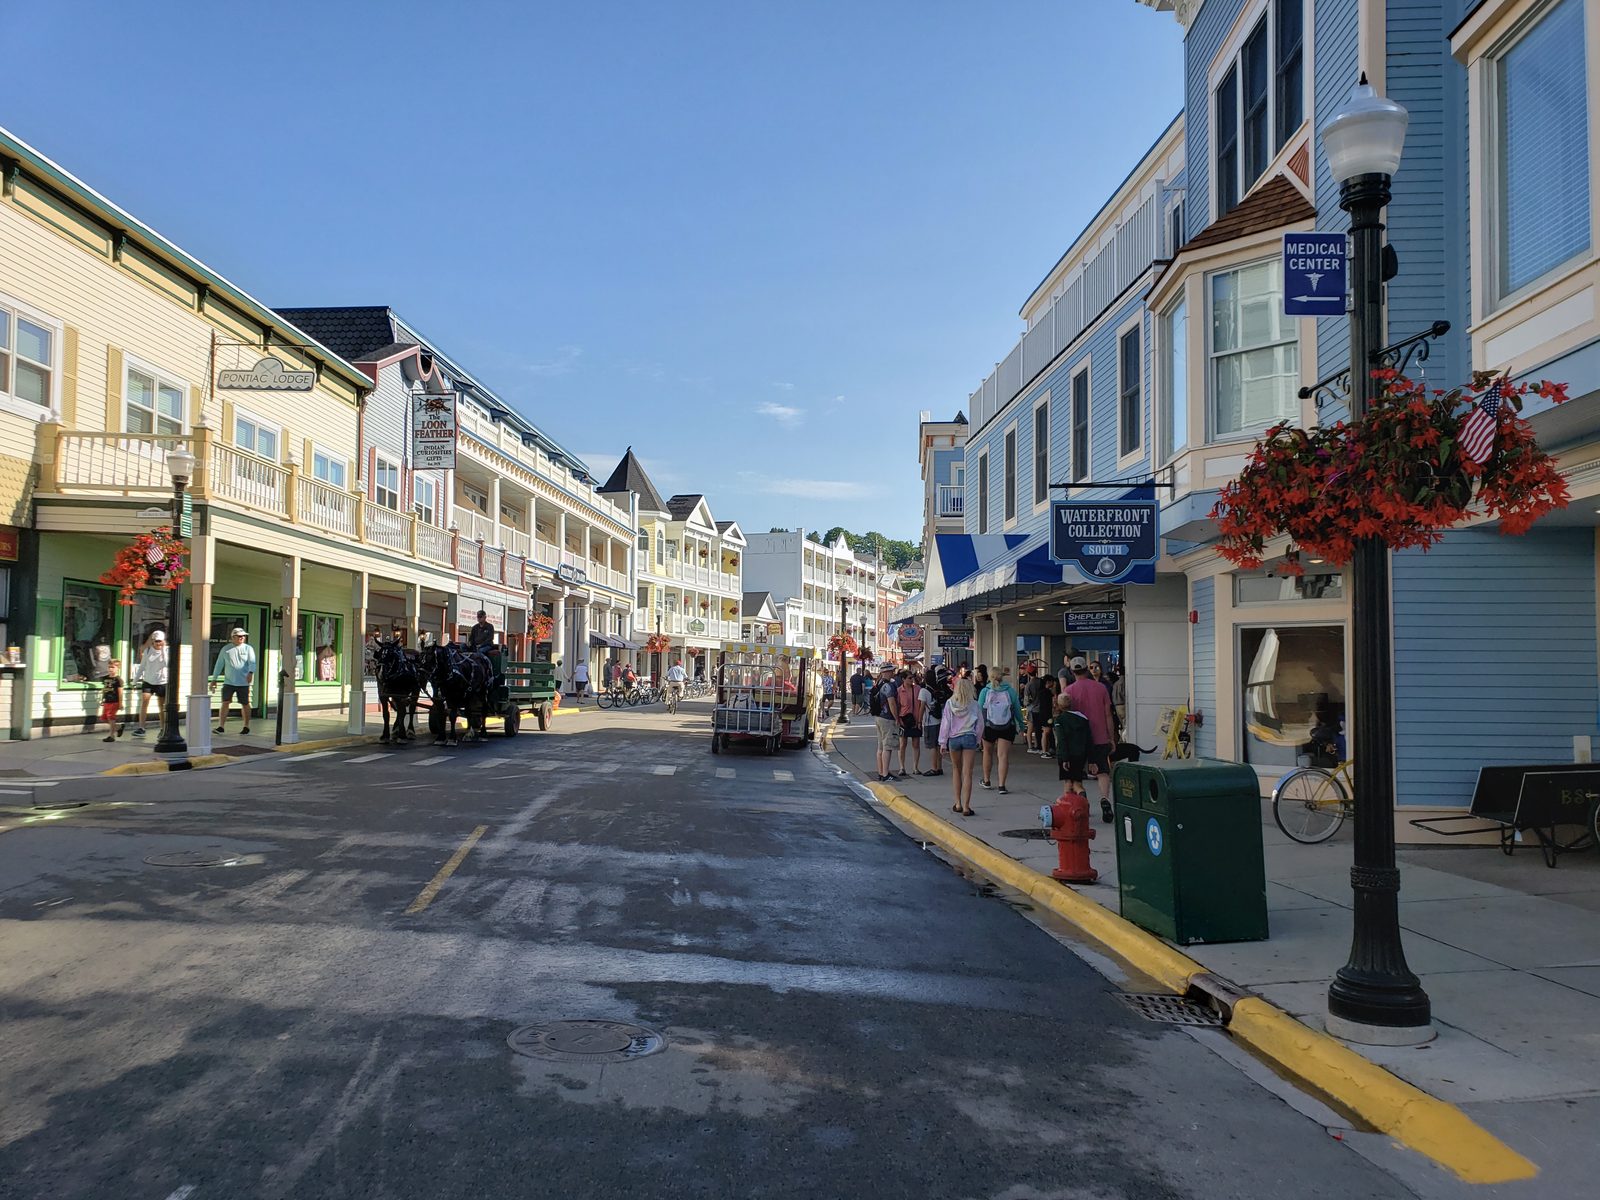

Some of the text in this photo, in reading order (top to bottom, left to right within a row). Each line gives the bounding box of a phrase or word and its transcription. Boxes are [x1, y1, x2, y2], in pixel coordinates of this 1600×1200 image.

[1287, 243, 1344, 255] MEDICAL
[1289, 258, 1340, 270] CENTER
[223, 373, 310, 384] PONTIAC LODGE
[421, 420, 447, 429] LOON
[415, 430, 454, 438] FEATHER
[1060, 508, 1151, 524] WATERFRONT
[1068, 524, 1141, 538] COLLECTION
[1088, 544, 1122, 555] SOUTH
[1068, 612, 1115, 620] SHEPLER'S
